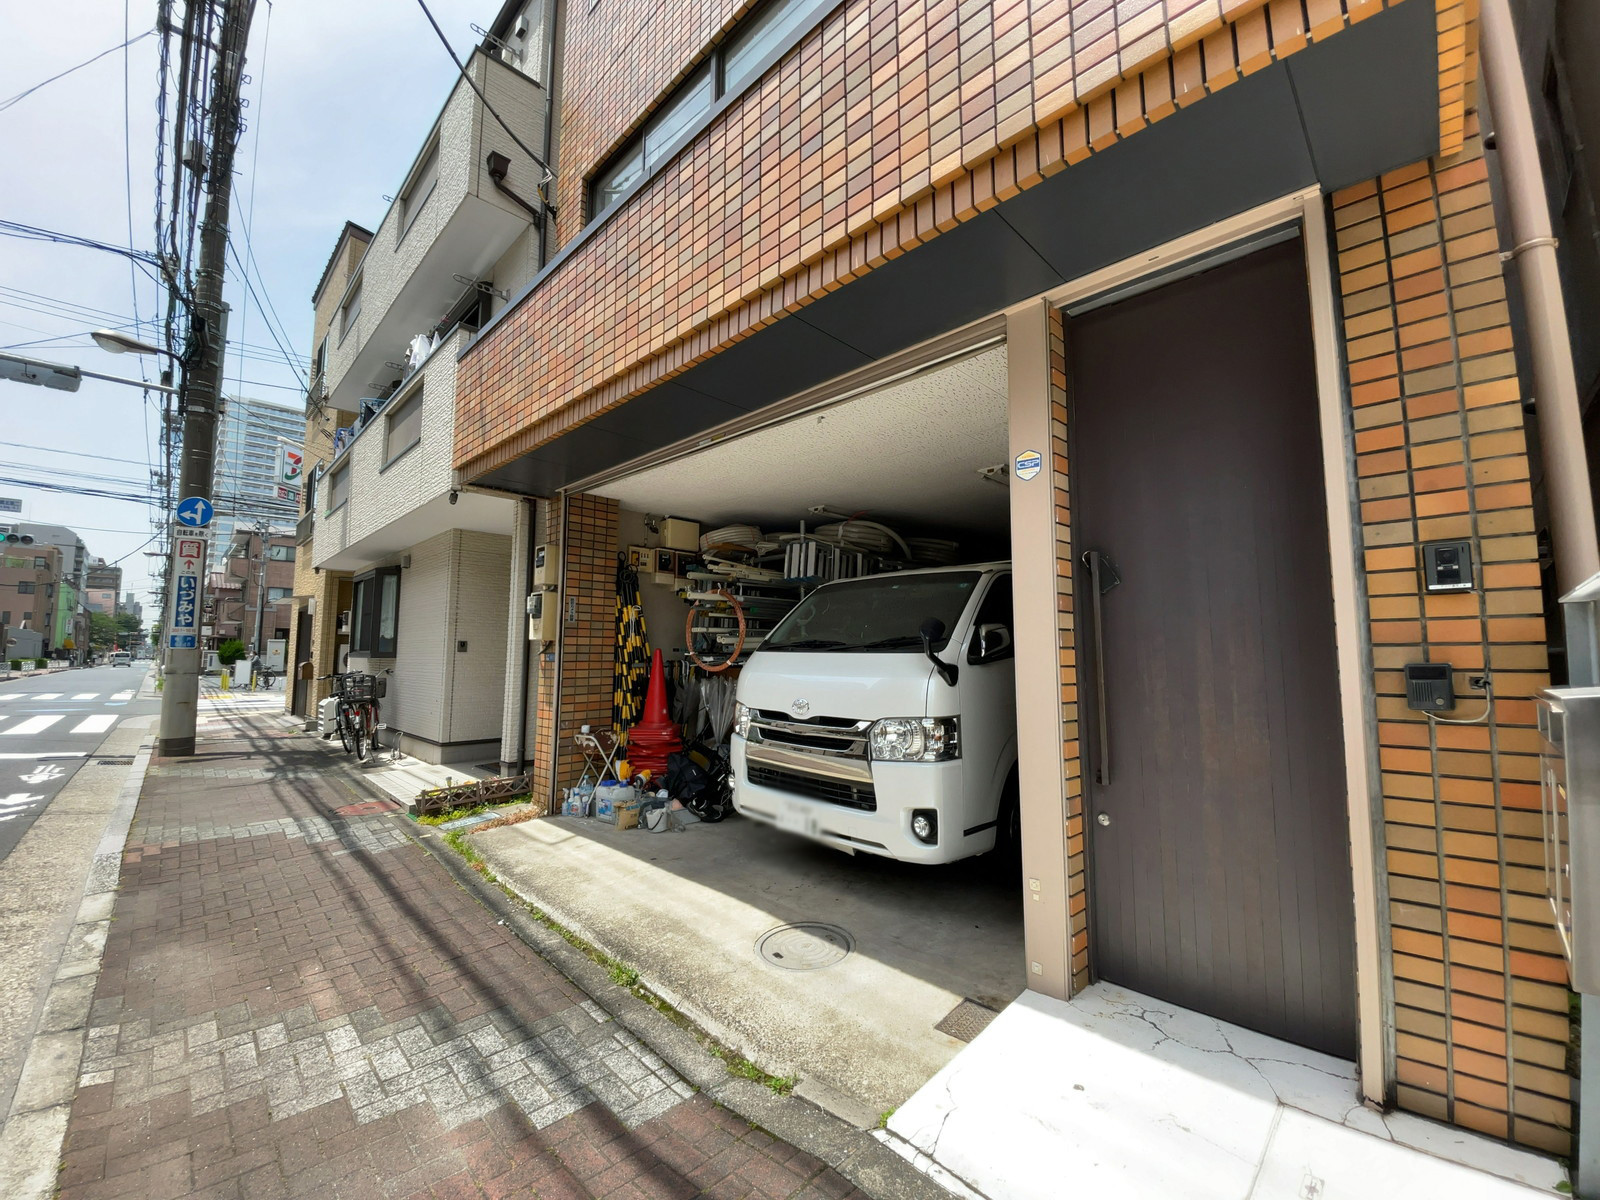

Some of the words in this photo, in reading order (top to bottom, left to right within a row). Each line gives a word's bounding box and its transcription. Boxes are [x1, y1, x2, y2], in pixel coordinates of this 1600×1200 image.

[1017, 459, 1040, 469] CSP
[177, 576, 195, 626] いづみや
